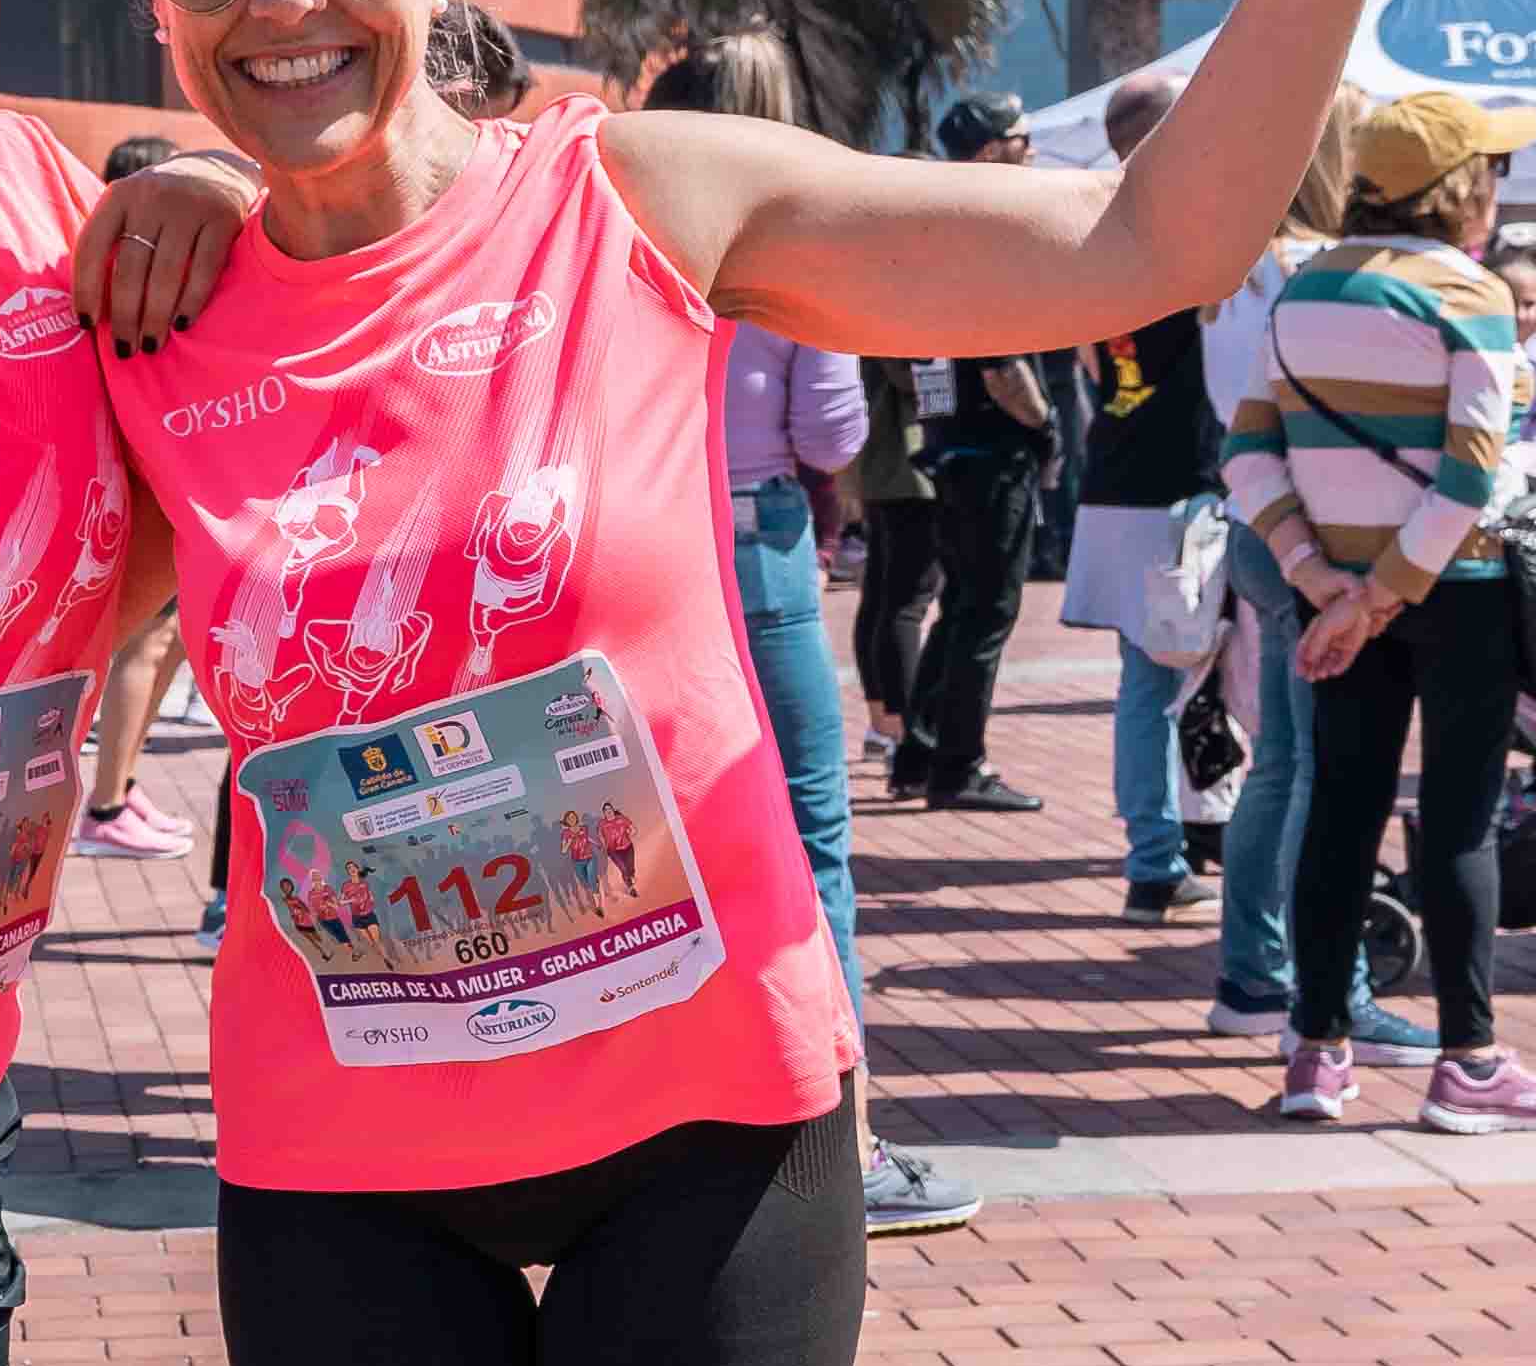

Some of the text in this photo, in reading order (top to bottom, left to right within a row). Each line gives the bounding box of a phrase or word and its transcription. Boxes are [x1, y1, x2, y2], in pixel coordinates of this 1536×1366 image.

[163, 376, 287, 436] OYSHO
[388, 853, 544, 932] 112
[329, 912, 688, 1002] CARRERA DE LA MUJER GRAN CANARIA
[455, 932, 509, 964] 660
[615, 961, 681, 999] Santander
[364, 1026, 429, 1046] OYSHO
[474, 1011, 550, 1036] ASTURIANA
